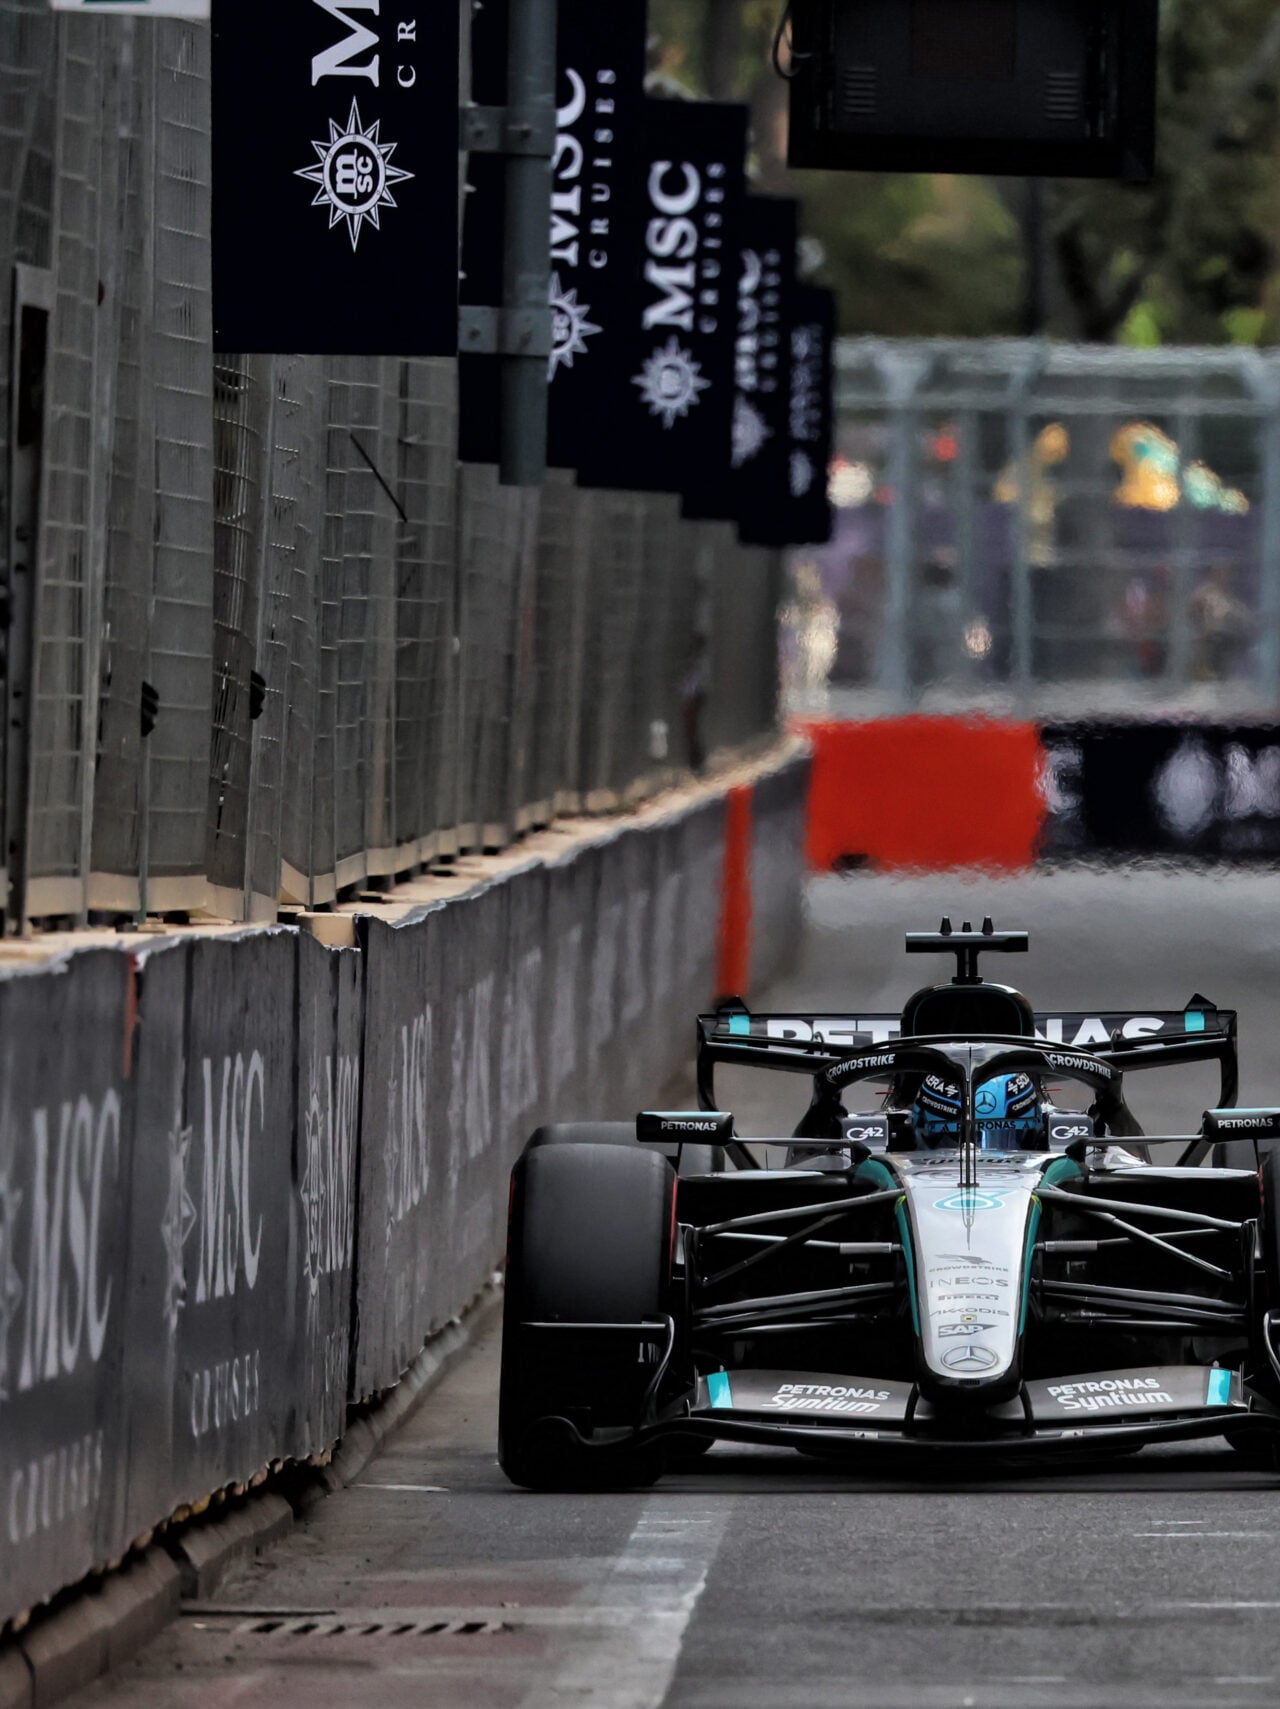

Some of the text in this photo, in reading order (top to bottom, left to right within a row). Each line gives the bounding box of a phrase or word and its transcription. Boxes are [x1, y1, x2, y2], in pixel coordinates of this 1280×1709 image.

[589, 69, 616, 268] CRUISES
[641, 160, 701, 332] MSC
[827, 1053, 896, 1079] CROWDSTRIKE
[1049, 1053, 1112, 1080] CROWDSTRIKE
[660, 1121, 718, 1131] PETRONAS
[1051, 1125, 1089, 1140] G42
[1217, 1117, 1274, 1129] PETRONAS
[846, 1126, 884, 1141] G42
[196, 1049, 264, 1303] MSC
[18, 1088, 121, 1392] MSC
[929, 1277, 1009, 1289] INEOS
[939, 1324, 984, 1337] SAP
[777, 1384, 891, 1401] PETRONAS
[1048, 1378, 1161, 1398] PETRONAS
[761, 1394, 881, 1414] Syntium
[1056, 1389, 1174, 1411] Syntium
